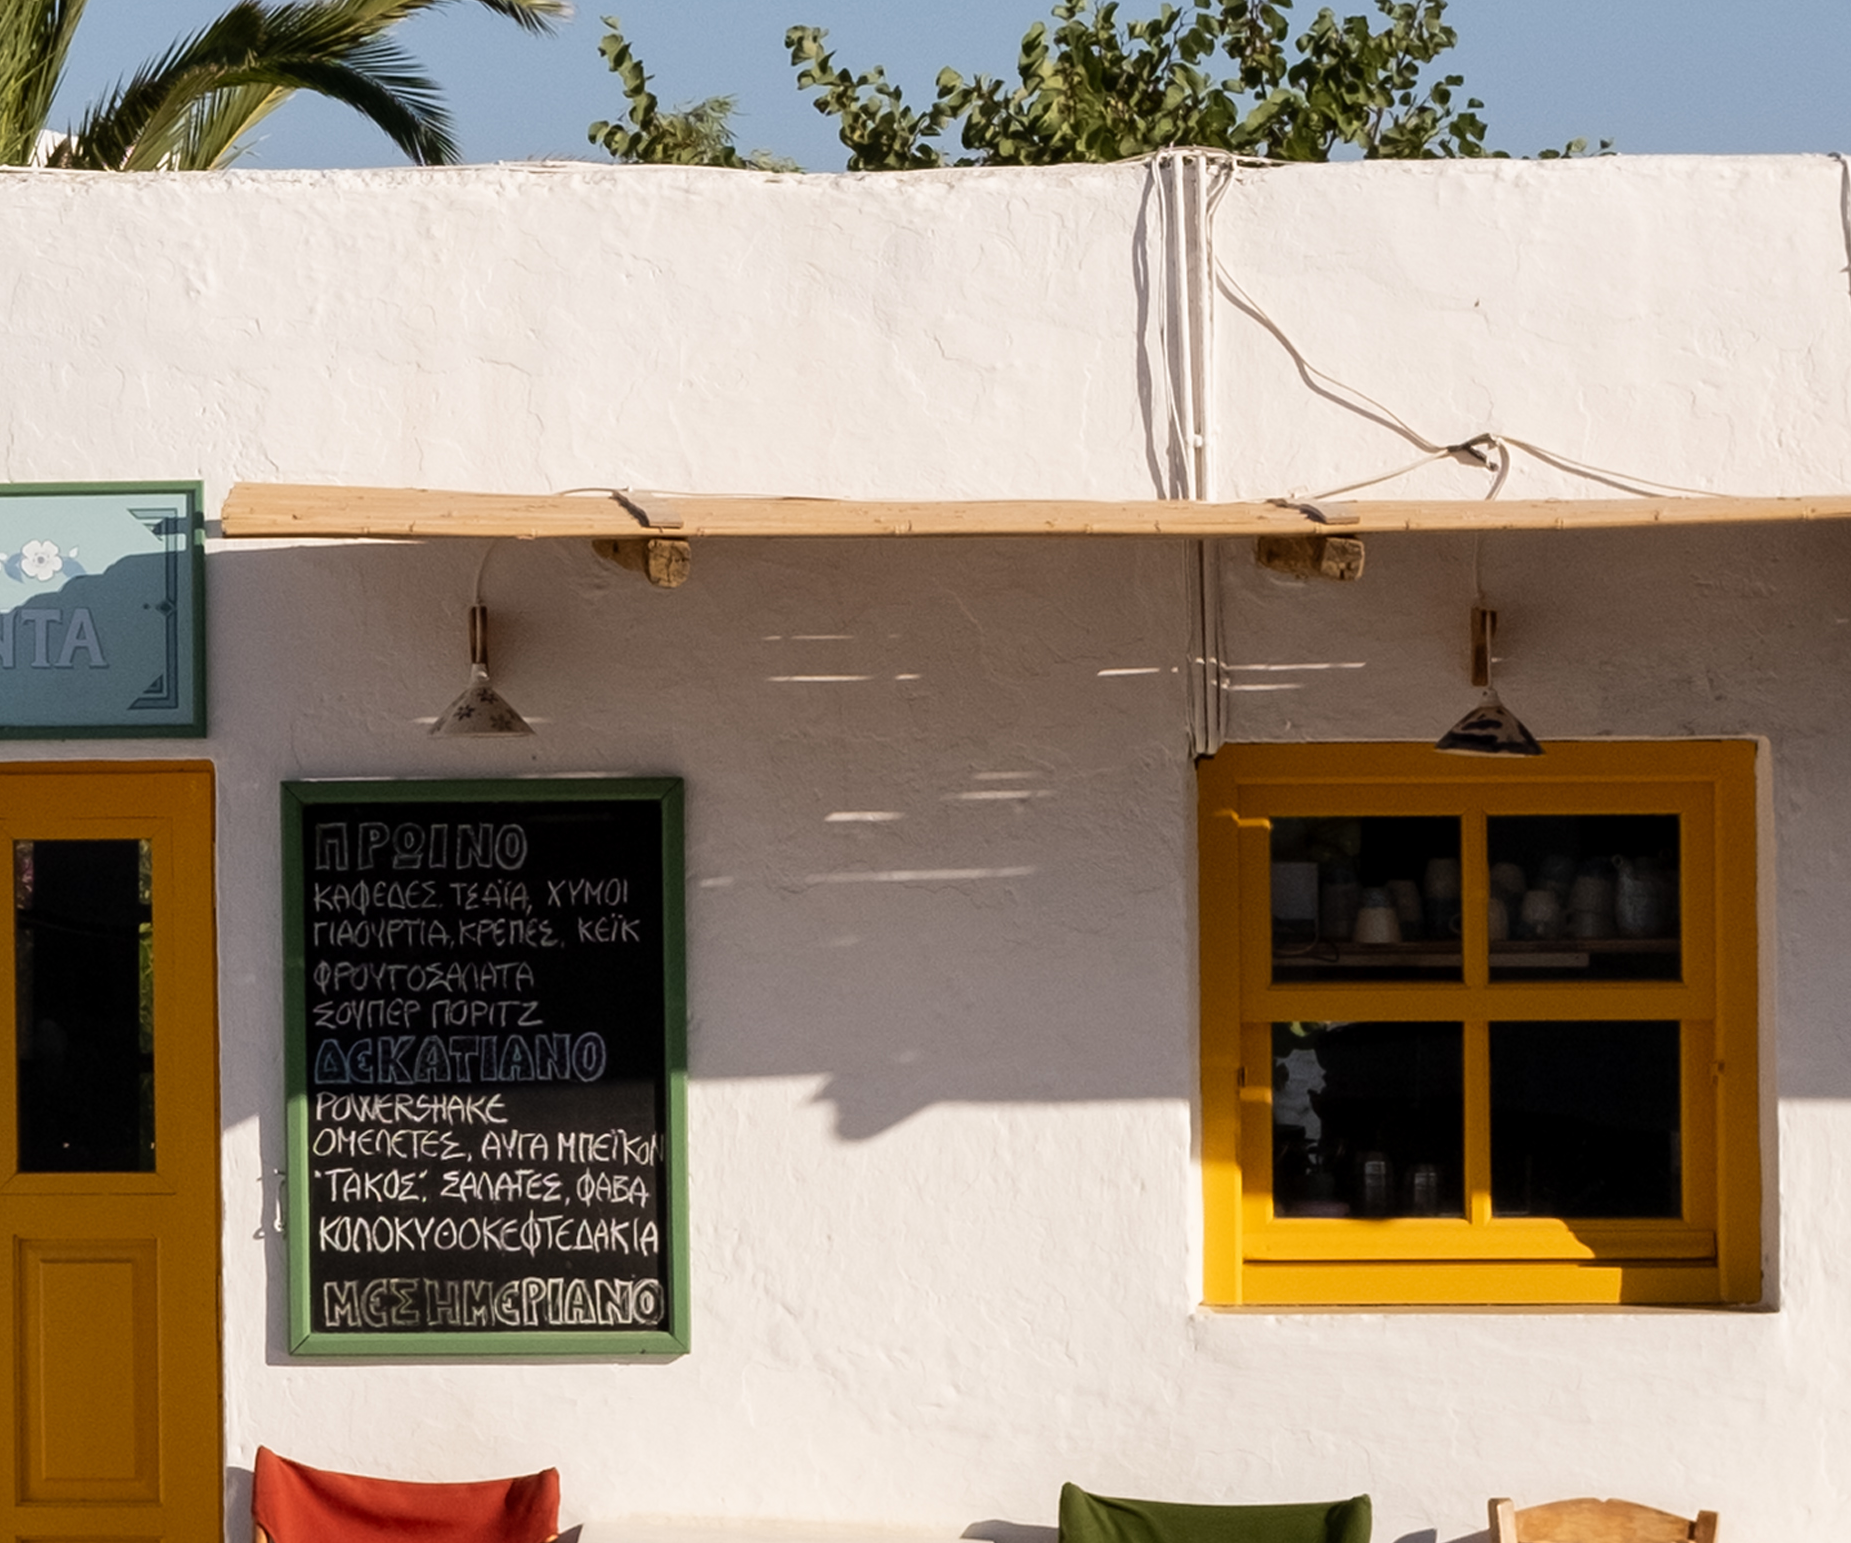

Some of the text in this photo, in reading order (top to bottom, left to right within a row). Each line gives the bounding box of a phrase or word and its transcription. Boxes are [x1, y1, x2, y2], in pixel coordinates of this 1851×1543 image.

[314, 823, 527, 869] ΠΡΩΙΝΟ
[548, 878, 629, 907] ΧΥΜΟΙ
[578, 914, 641, 943] ΚΕΪΚ
[313, 961, 535, 992] ΦΡΟΥΤΟΣΑΛΑΤΑ
[312, 998, 544, 1029] ΣΟΥΠΕΡ ΠΟΡΙΤΖ
[314, 1031, 608, 1084] ΔΕΚΑΤΙΑΝΟ
[316, 1093, 509, 1125] POWERSHAKE
[312, 1129, 473, 1161] ΟΜΕΛΕΤΕΣ,
[481, 1130, 550, 1161] ΑΥΓΑ
[442, 1171, 571, 1206] ΣΑΛΑΤΕΣ,
[577, 1169, 650, 1207] ΦΑΒΑ
[319, 1212, 659, 1256] ΚΟΛΟΚΥΘΟΚΕΦΤΕΔΑΚΙΑ
[323, 1277, 665, 1328] ΜΕΣΗΜΕΡΙΑΝΟ
